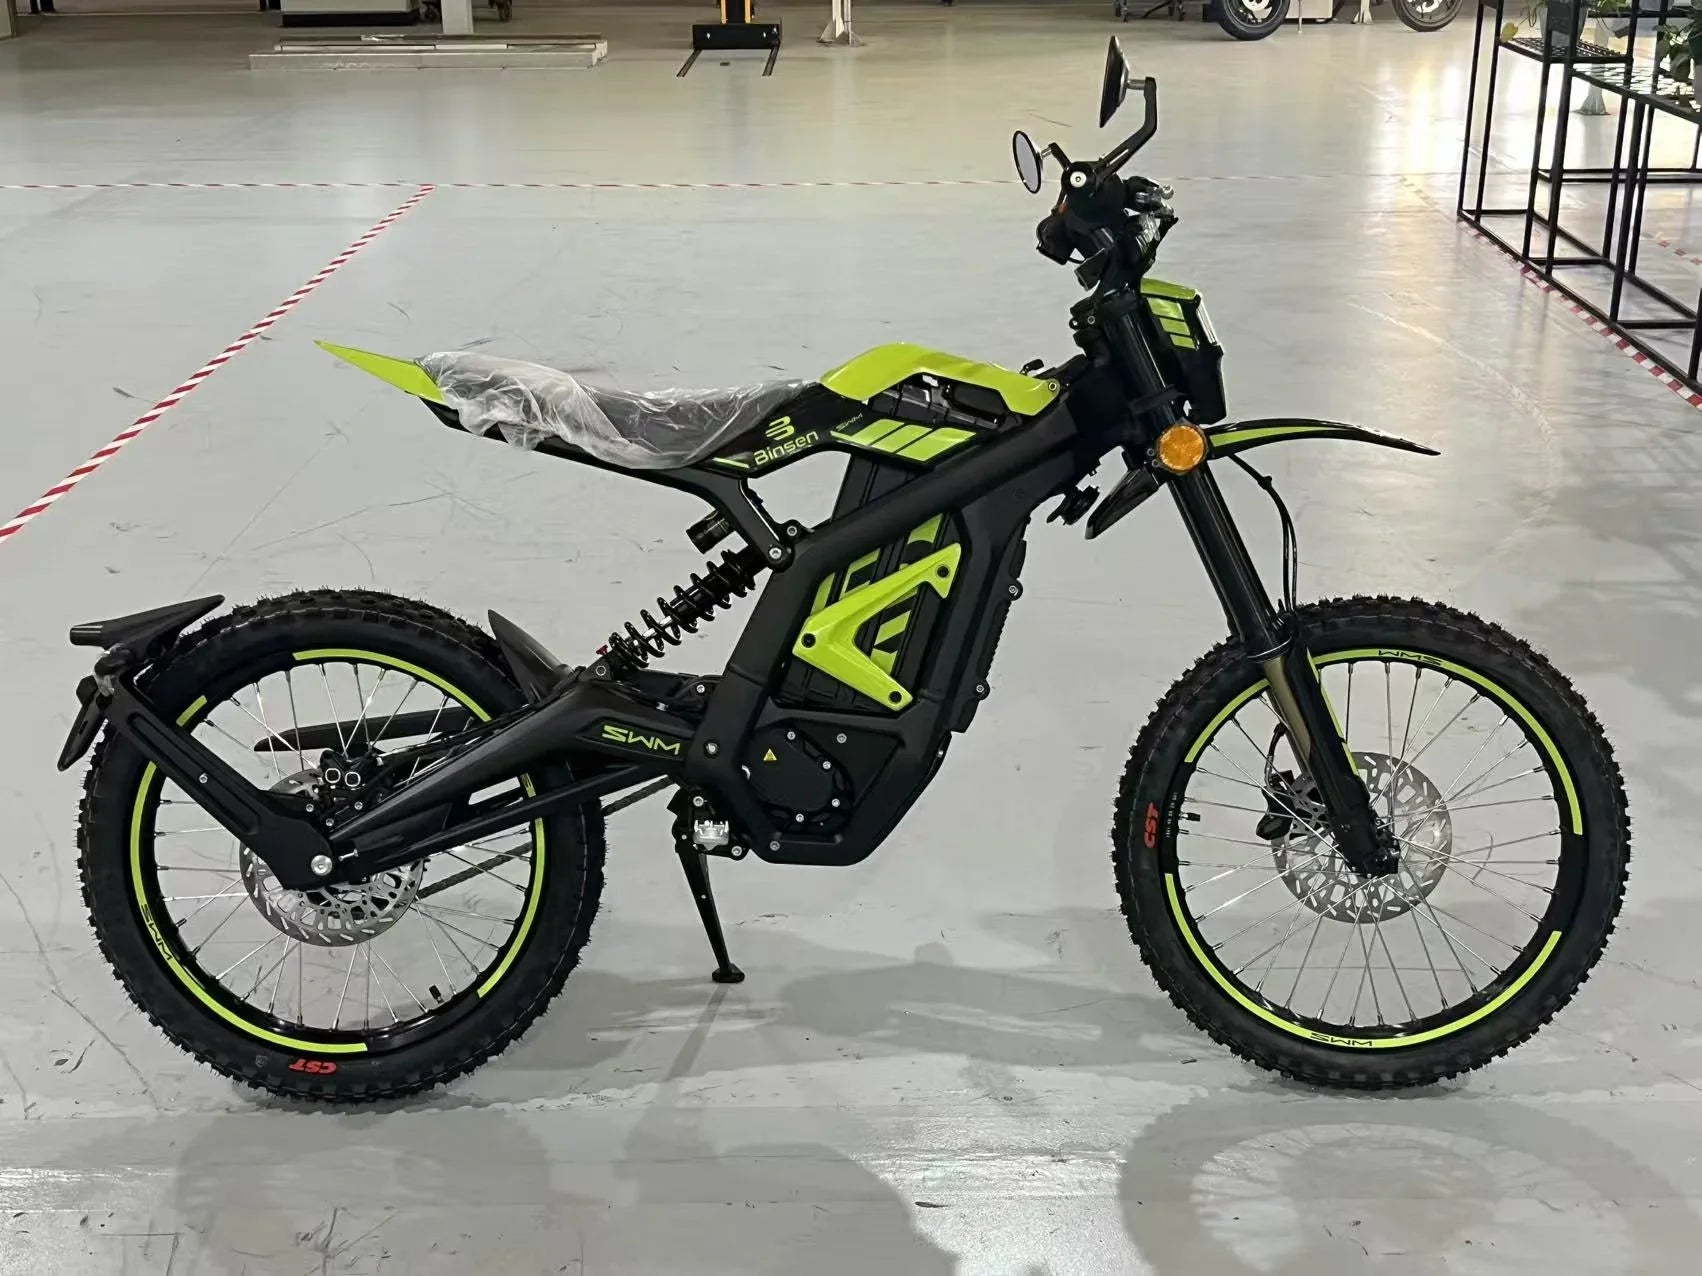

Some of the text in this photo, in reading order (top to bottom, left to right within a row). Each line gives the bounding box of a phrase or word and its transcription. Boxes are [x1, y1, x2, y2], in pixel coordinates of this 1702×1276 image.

[753, 431, 819, 466] Binsen
[602, 724, 681, 755] SWM
[1144, 801, 1158, 849] CST
[140, 903, 173, 961] SWM
[1310, 1032, 1373, 1047] SWM
[288, 1058, 337, 1074] CST
